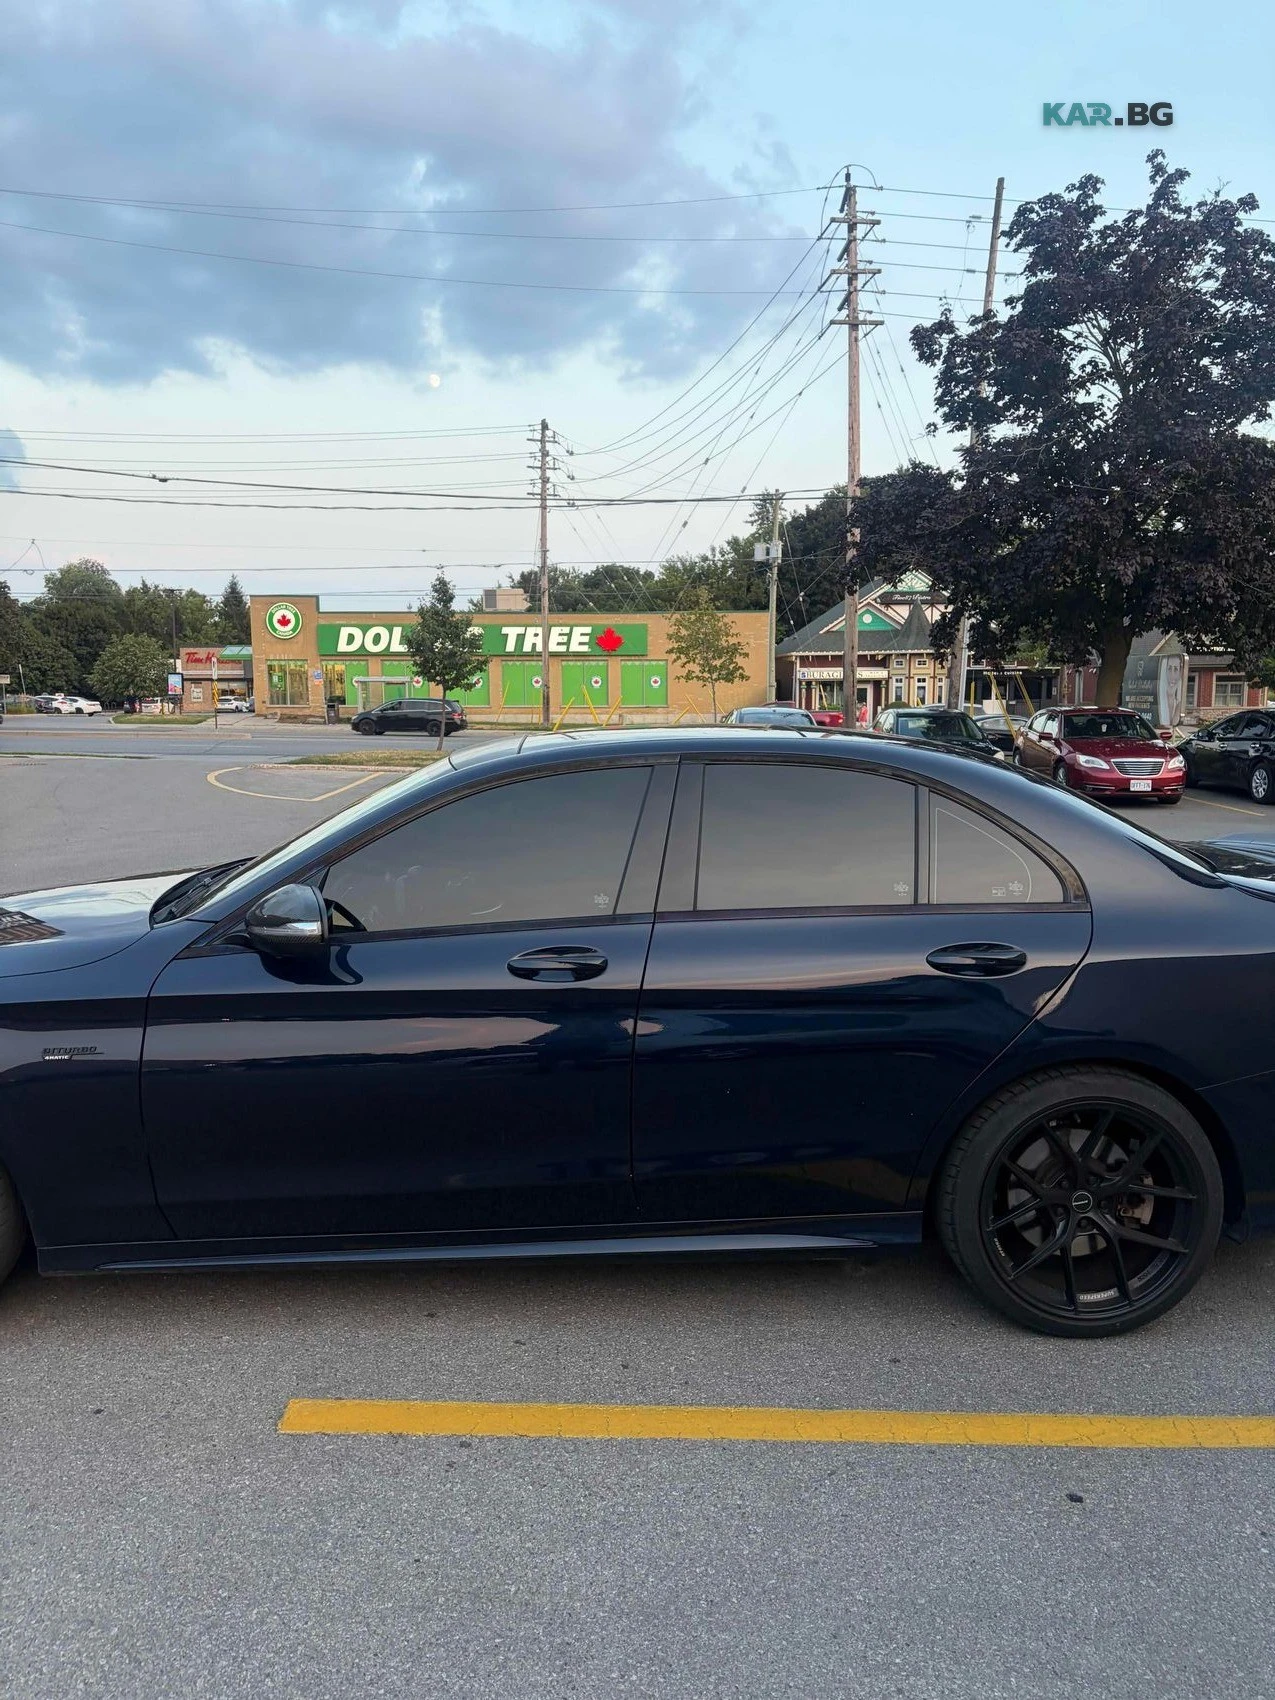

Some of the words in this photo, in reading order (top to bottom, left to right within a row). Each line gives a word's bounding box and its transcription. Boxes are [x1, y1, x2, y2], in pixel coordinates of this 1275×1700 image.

[501, 627, 592, 652] TREE
[185, 652, 203, 664] Tim
[43, 1047, 97, 1055] BITURBO
